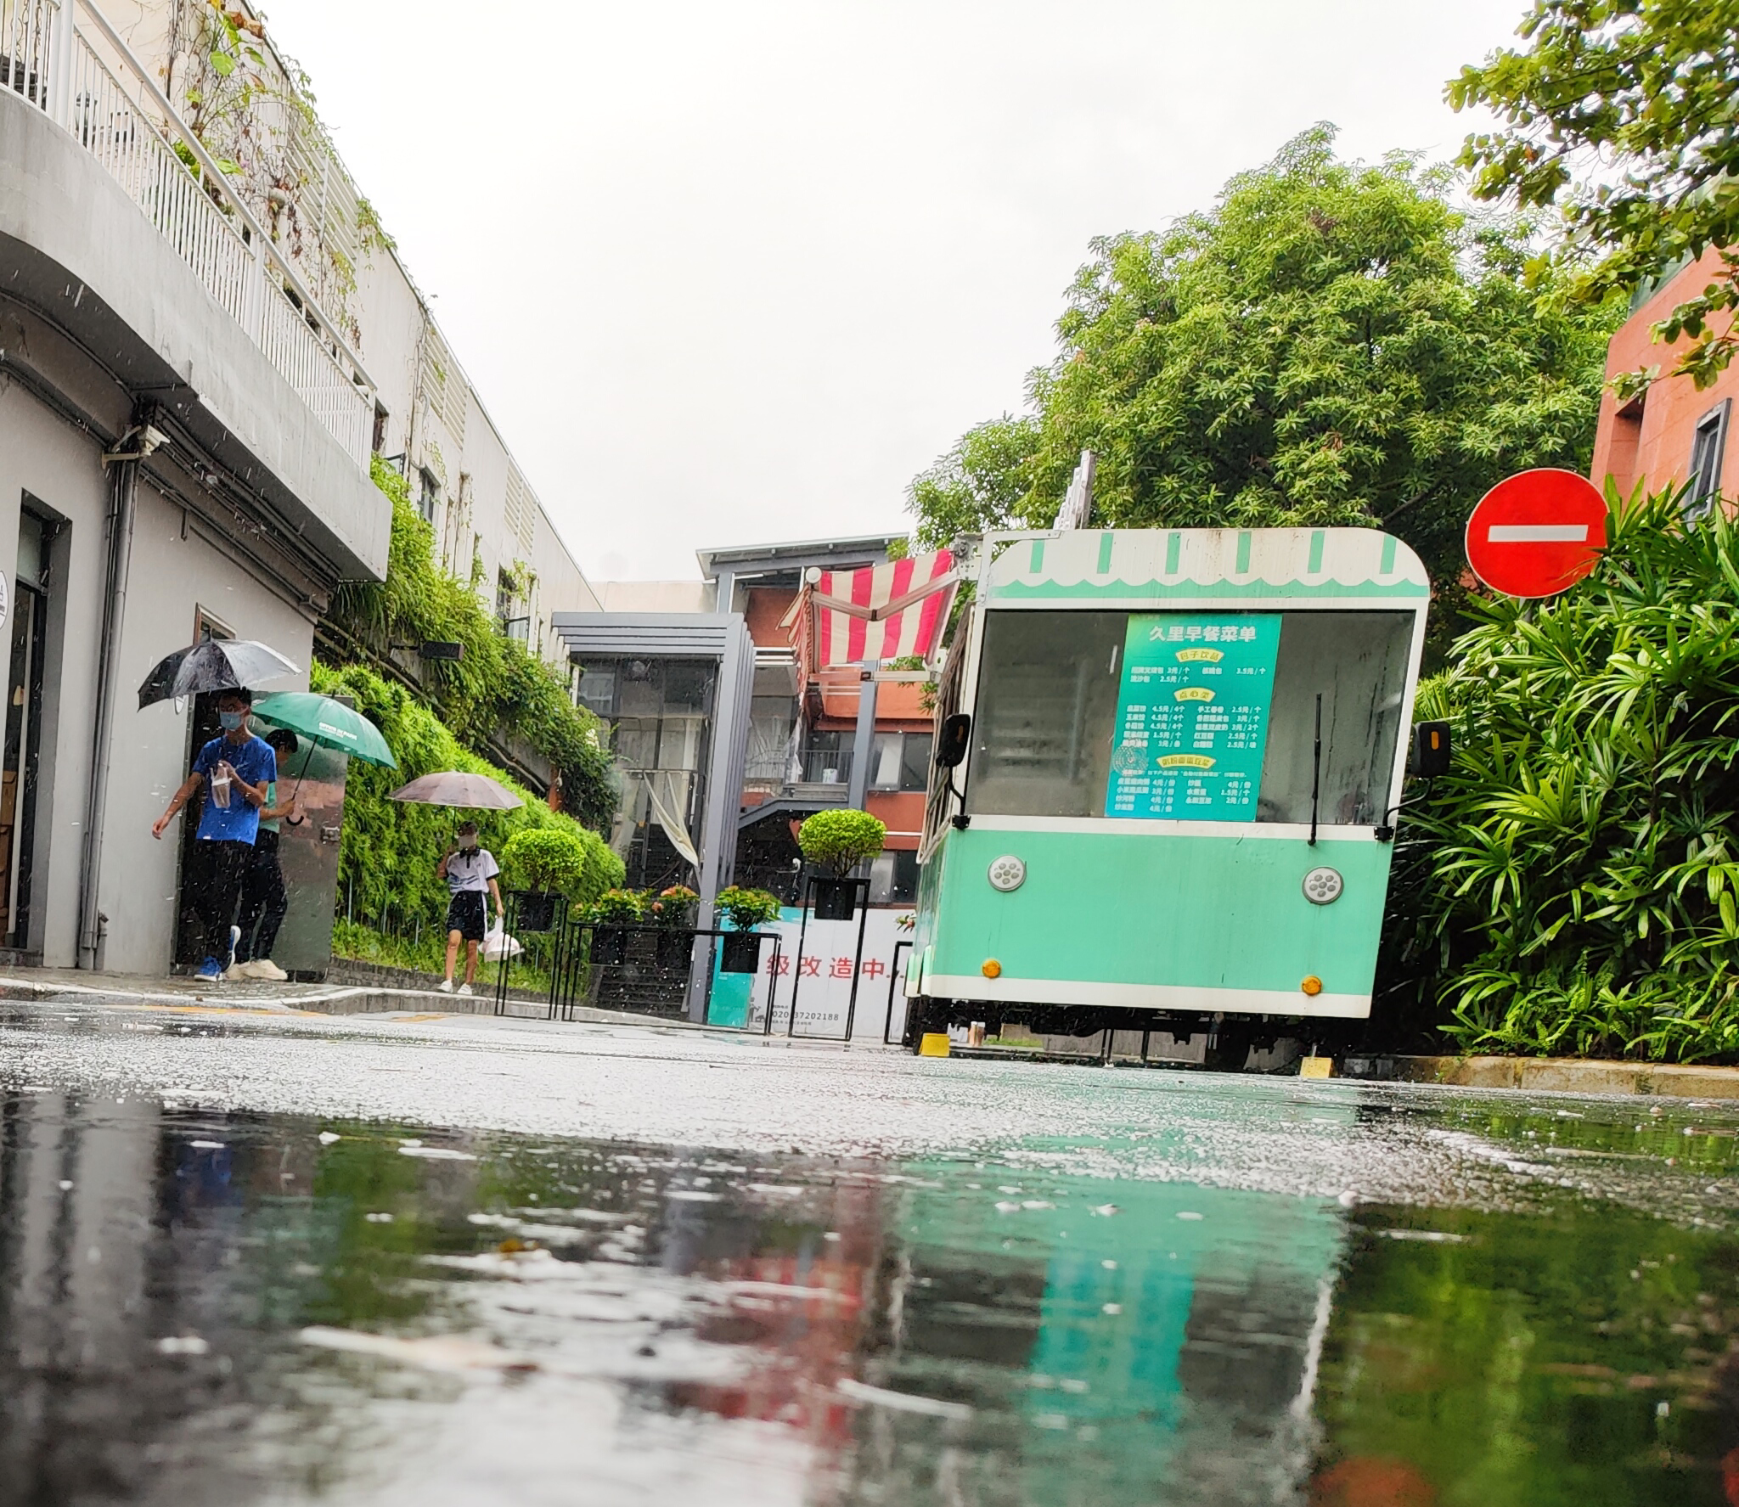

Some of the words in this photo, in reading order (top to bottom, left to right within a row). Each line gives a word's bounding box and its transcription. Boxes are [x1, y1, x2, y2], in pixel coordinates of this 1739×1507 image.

[1149, 626, 1257, 642] 久里早餐菜单
